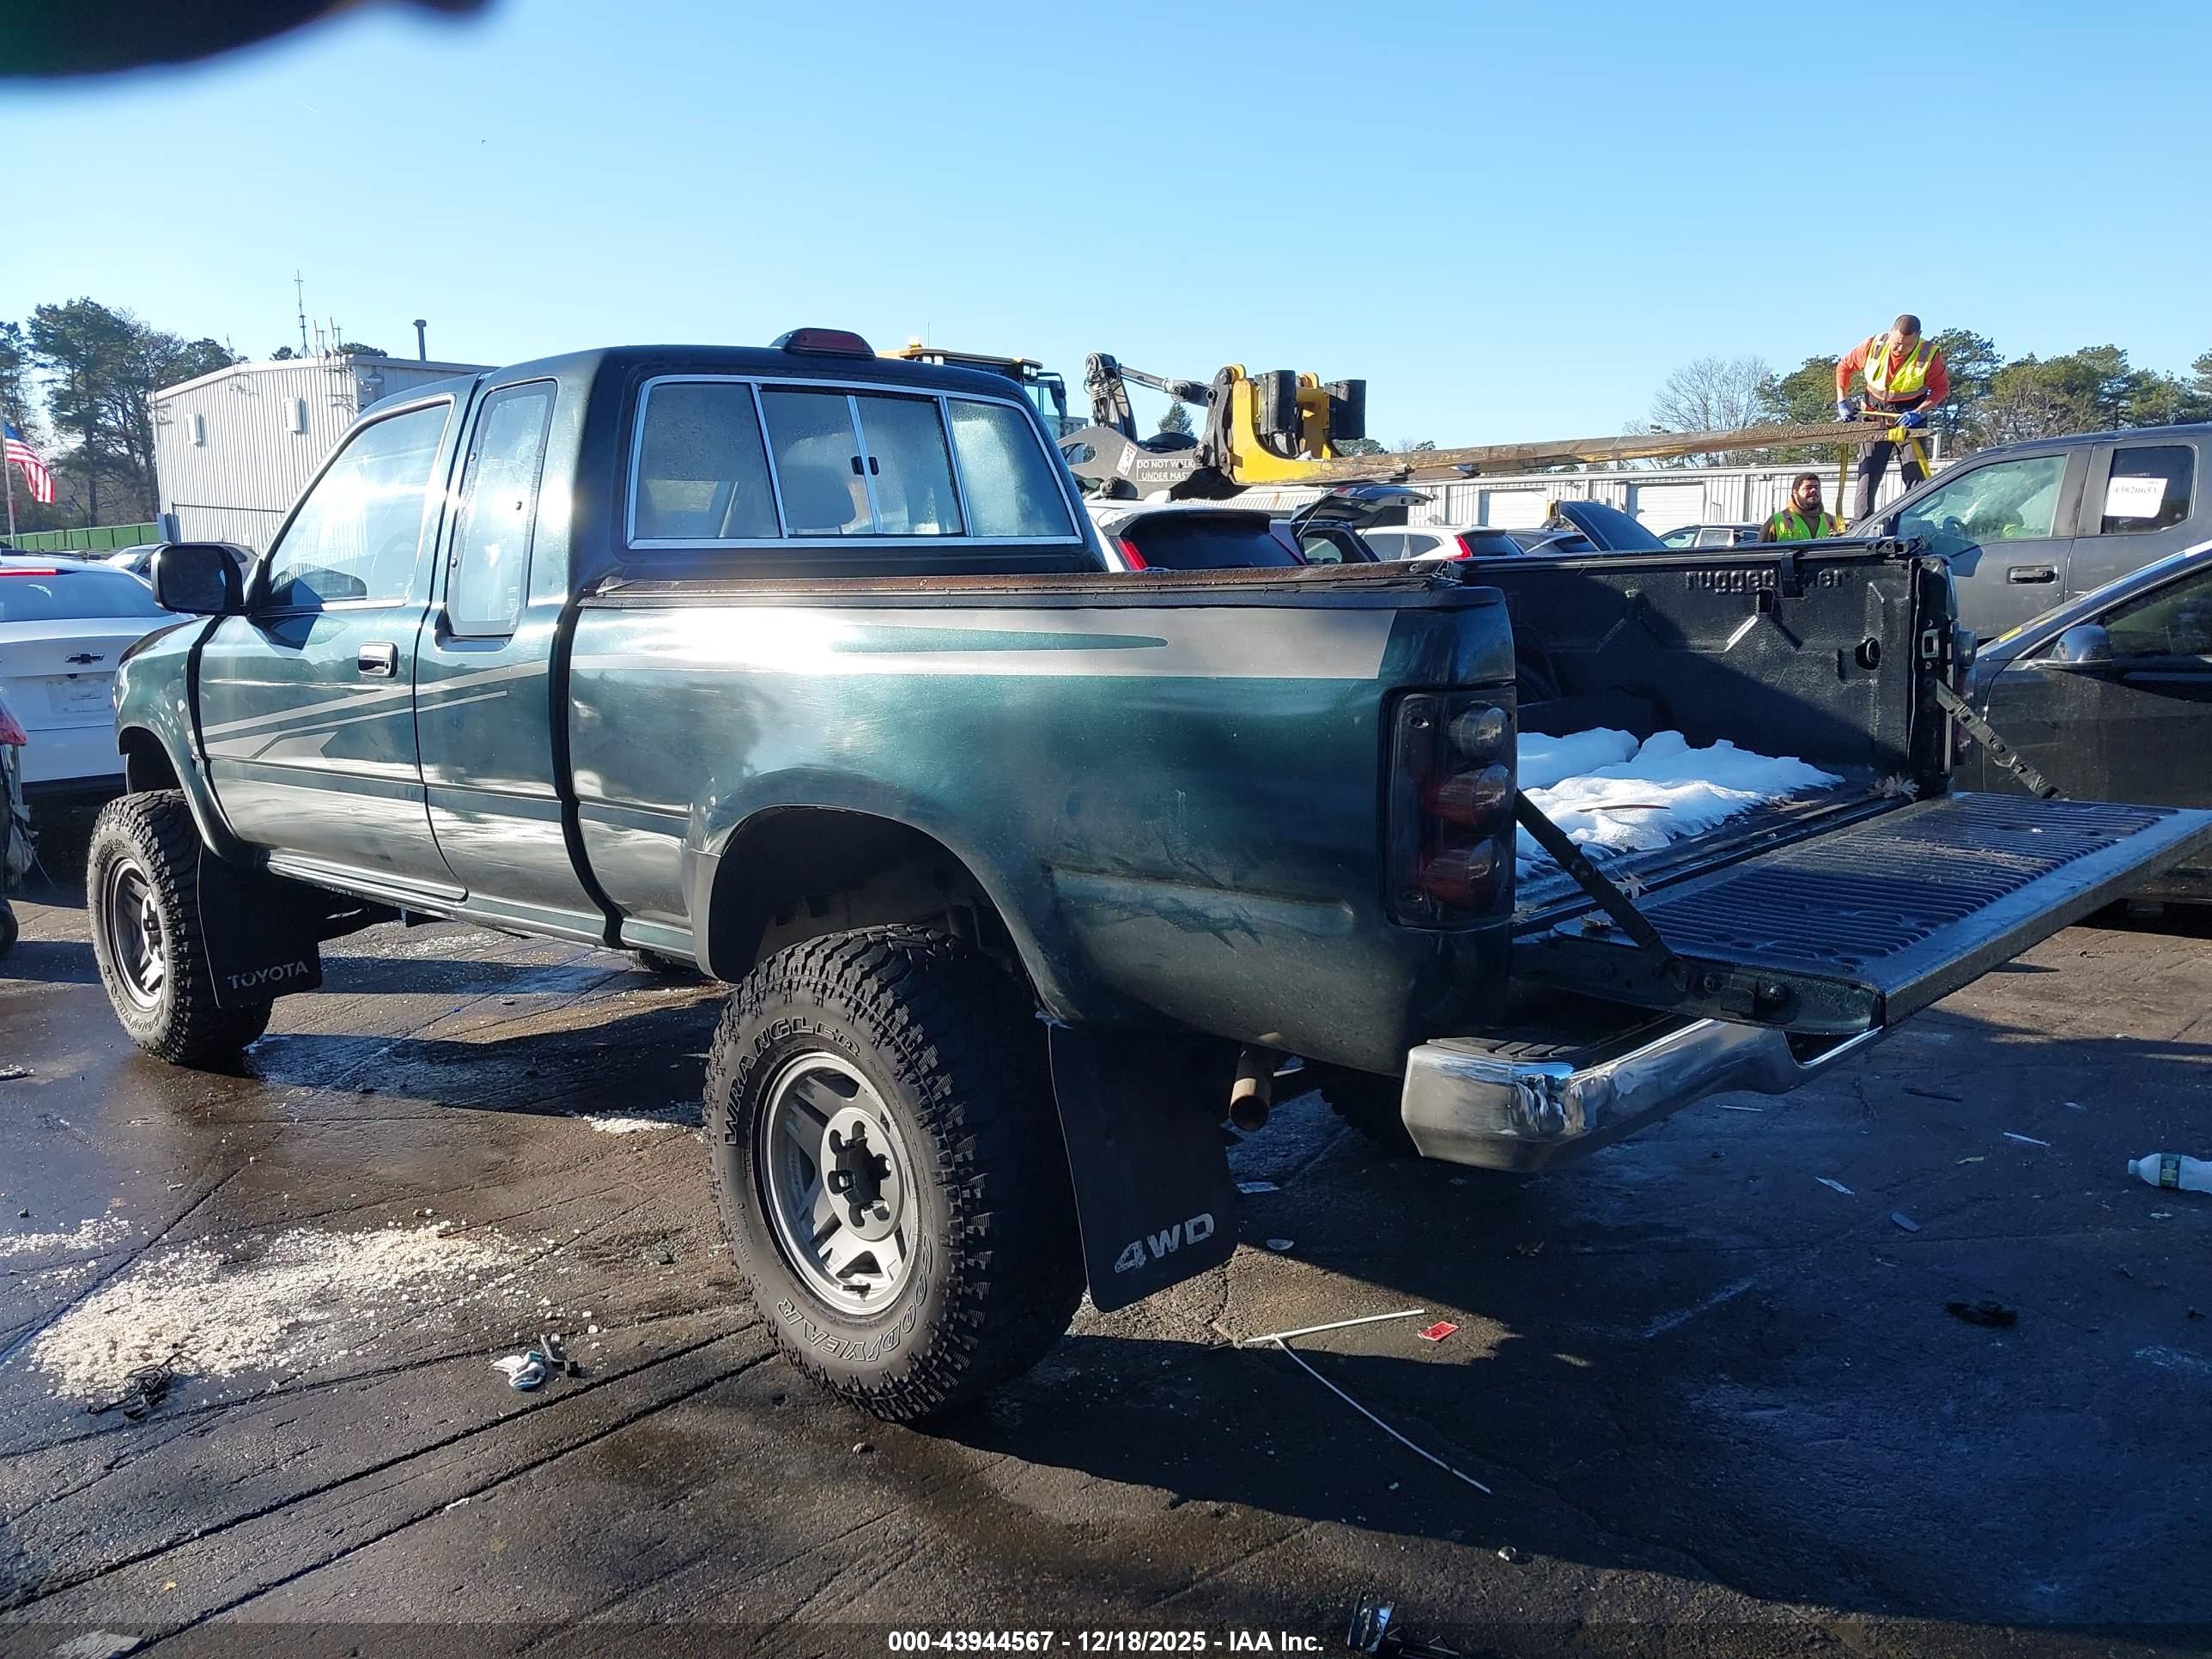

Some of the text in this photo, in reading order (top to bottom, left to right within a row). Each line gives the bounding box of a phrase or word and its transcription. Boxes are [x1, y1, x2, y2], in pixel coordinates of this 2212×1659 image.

[1138, 460, 1150, 469] DO
[1152, 460, 1169, 469] NOT
[1170, 472, 1190, 481] MAST
[227, 961, 309, 989] TOYOTA
[723, 1016, 861, 1146] WRANGLER
[1114, 1212, 1214, 1273] 4WD
[776, 1233, 933, 1362] GOODYEAR
